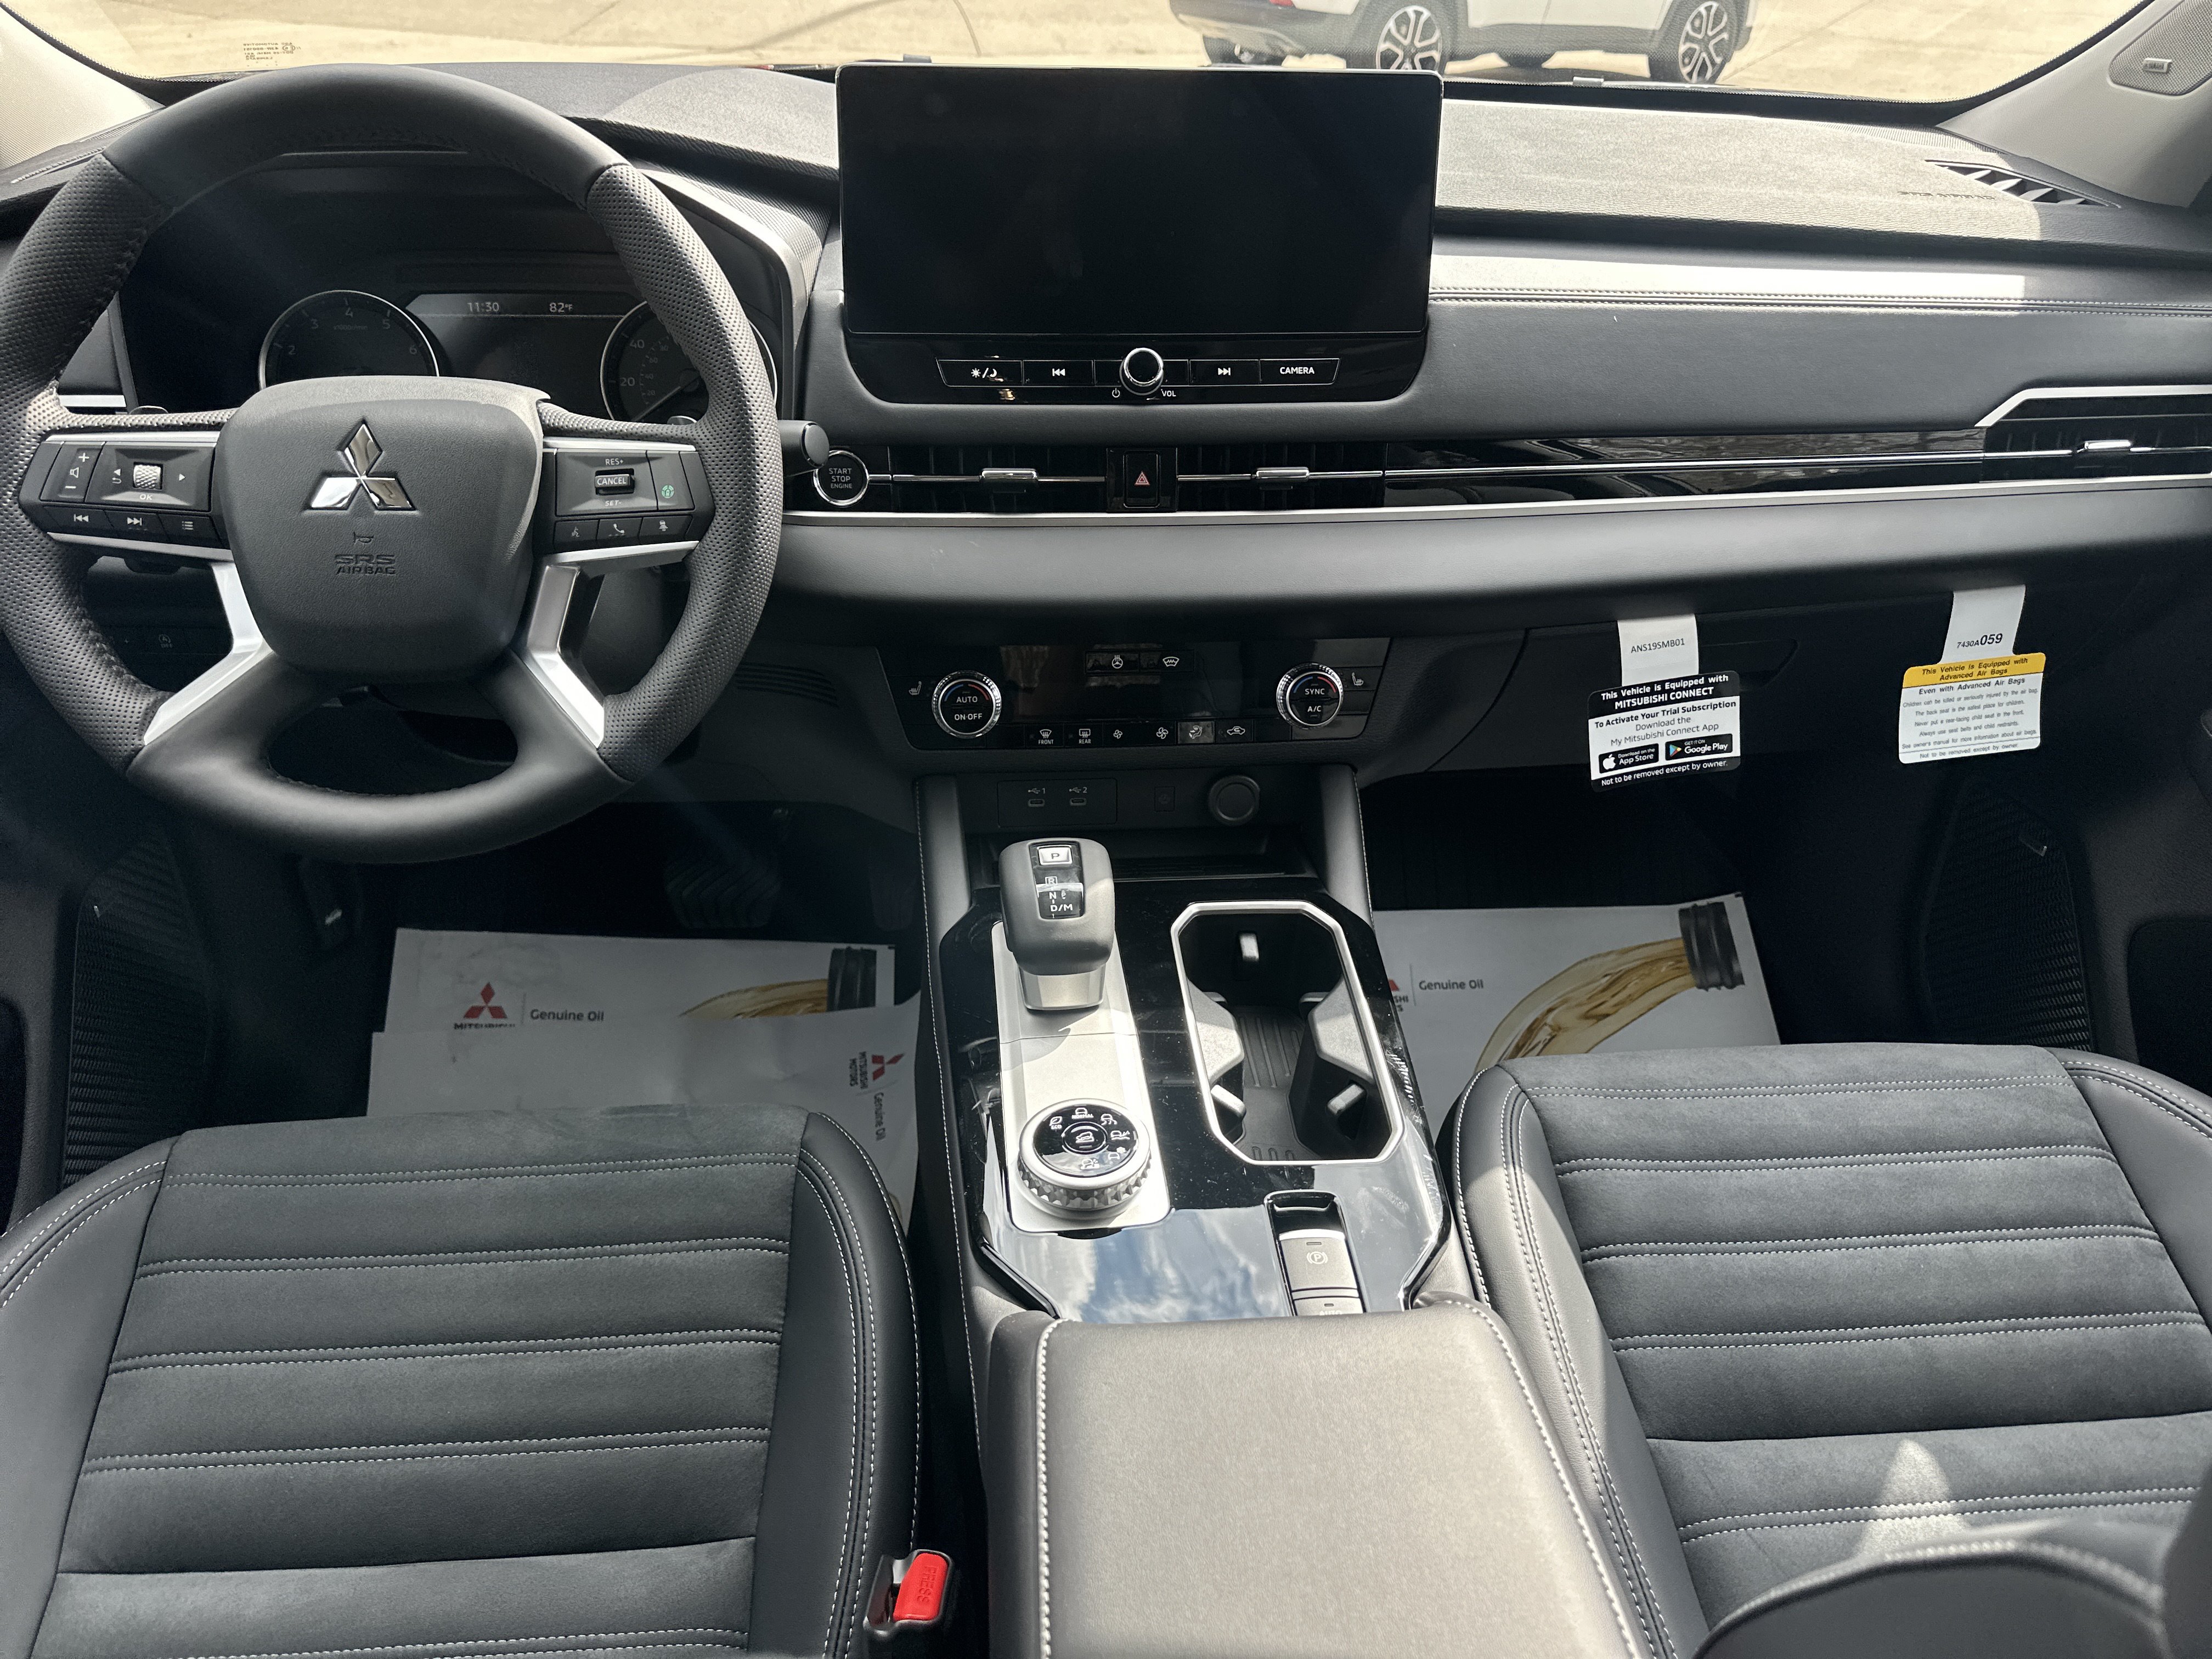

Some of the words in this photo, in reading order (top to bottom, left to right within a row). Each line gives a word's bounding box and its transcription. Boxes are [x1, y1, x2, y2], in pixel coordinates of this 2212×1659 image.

[345, 307, 353, 318] 4
[467, 302, 500, 312] 11:30
[311, 319, 319, 329] 3
[382, 319, 390, 329] 5
[288, 345, 296, 355] 2
[629, 340, 645, 349] 40
[410, 346, 417, 355] 6
[620, 377, 635, 386] 20
[597, 477, 627, 486] CANCEL
[334, 554, 396, 565] SRS
[1631, 638, 1685, 653] ANS19SMB01
[1978, 659, 2010, 669] Equipped
[1940, 672, 1973, 681] Advanced
[1601, 691, 1618, 701] This
[1621, 686, 1651, 697] Vehicle
[1654, 684, 1662, 692] is
[1664, 677, 1705, 690] Equipped
[1708, 675, 1729, 683] with
[1957, 681, 1991, 690] Advanced
[1615, 692, 1668, 709] MITSUBISHI
[1670, 687, 1714, 700] CONNECT
[1605, 715, 1639, 727] Activate
[1641, 712, 1658, 720] Your
[1661, 708, 1679, 716] Trial
[1681, 701, 1736, 713] Subscription
[1635, 719, 1675, 731] Download
[1677, 716, 1691, 724] the
[1611, 739, 1622, 747] My
[1624, 730, 1664, 743] Mitsubishi
[1666, 726, 1700, 736] Connect
[1702, 723, 1719, 732] App
[1684, 744, 1711, 754] Google
[1712, 743, 1728, 752] Play
[1619, 756, 1634, 766] App
[1635, 753, 1654, 762] Store
[1633, 767, 1664, 779] removed
[1666, 764, 1690, 775] except
[1691, 763, 1700, 771] by
[1702, 760, 1728, 769] owner.
[1050, 904, 1073, 912] D/M
[1419, 979, 1466, 990] Genuine
[1469, 979, 1484, 989] Oil
[529, 1008, 584, 1022] Genuine
[588, 1011, 604, 1022] Oil
[874, 1092, 884, 1127] Genuine
[917, 1566, 939, 1602] PRESS
